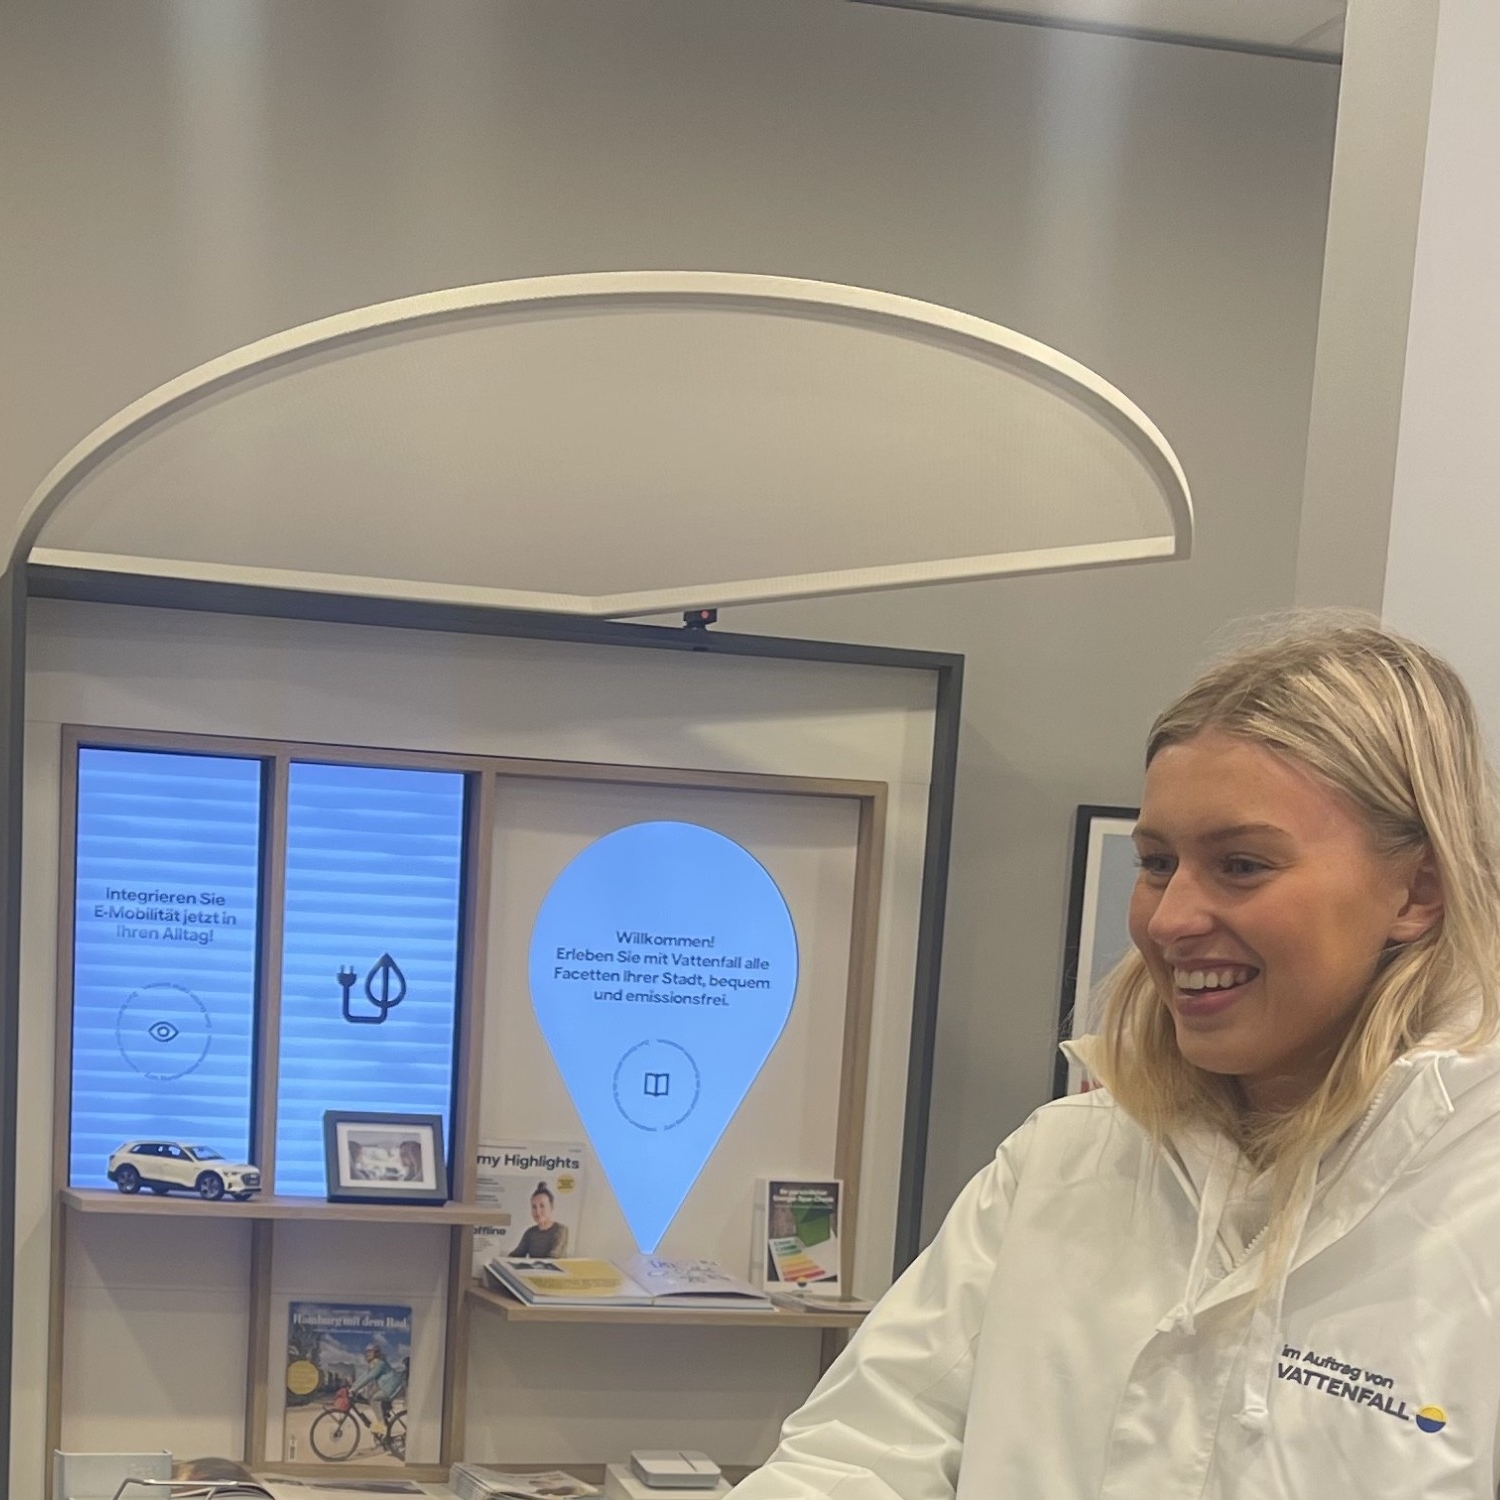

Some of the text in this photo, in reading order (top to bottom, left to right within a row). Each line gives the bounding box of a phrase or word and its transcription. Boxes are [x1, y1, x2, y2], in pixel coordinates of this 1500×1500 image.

[105, 887, 226, 906] Integrieren Sie
[94, 904, 237, 926] E-Mobilität jetzt in
[116, 924, 214, 945] Ihren Alltag!
[616, 931, 715, 948] Willkommen!
[556, 947, 770, 970] Erleben Sie mit Vattenfall alle
[553, 967, 771, 991] Facetten Ihrer Stadt, bequem
[593, 989, 730, 1006] und emissionsfrei.
[476, 1154, 580, 1171] my Highlights
[293, 1313, 342, 1328] Hamburg
[361, 1315, 385, 1327] dem
[1281, 1343, 1394, 1389] im Auftrag von
[1277, 1362, 1409, 1421] VATTENFALL
